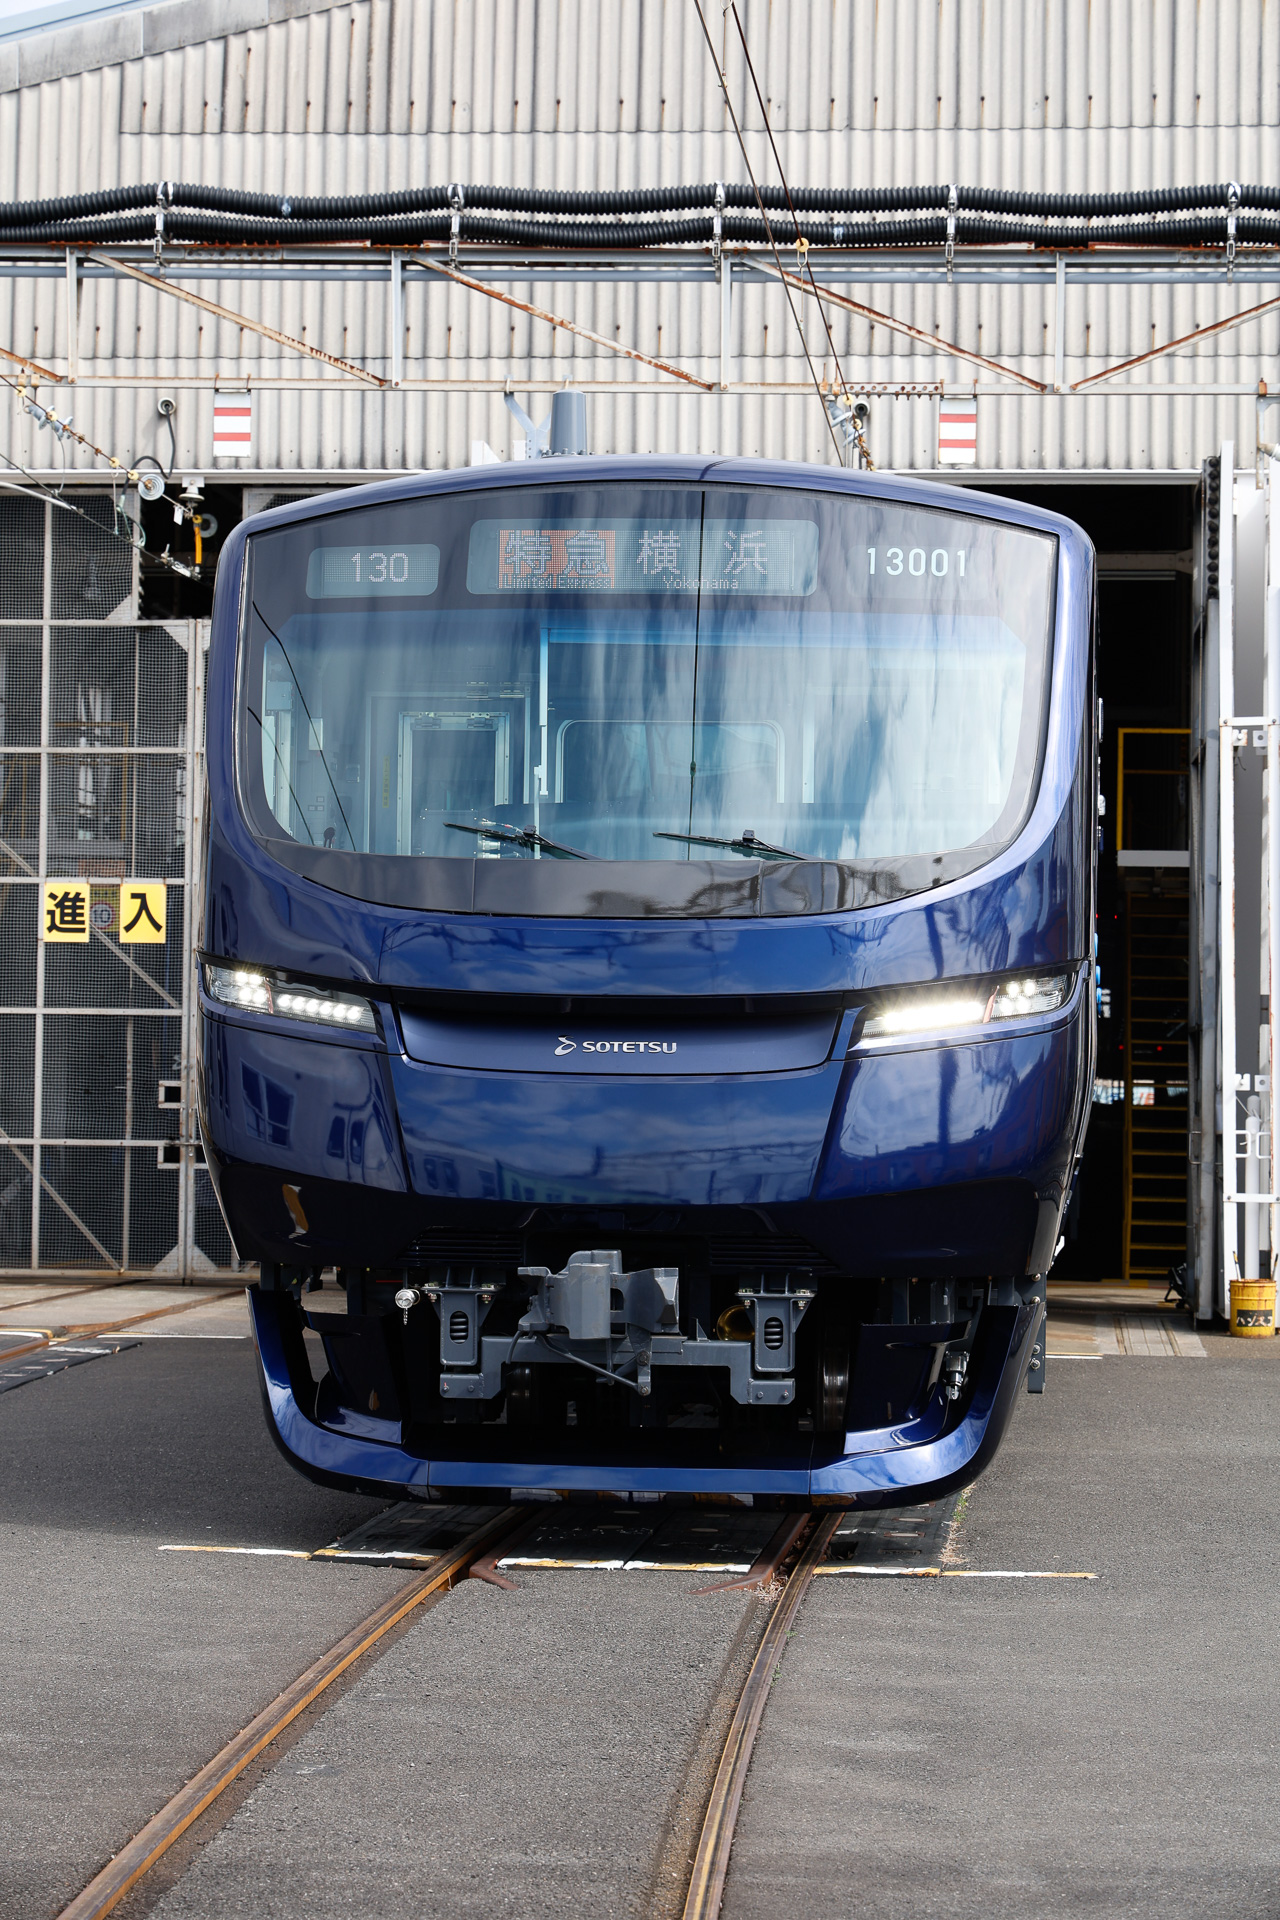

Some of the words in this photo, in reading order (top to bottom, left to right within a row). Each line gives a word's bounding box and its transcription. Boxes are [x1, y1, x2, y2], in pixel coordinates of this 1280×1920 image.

[351, 552, 409, 582] 130
[506, 530, 609, 574] 特急
[636, 530, 768, 574] 横浜
[867, 547, 966, 577] 13001
[504, 575, 552, 589] Limited
[559, 575, 609, 589] Express
[663, 575, 739, 589] Yokohama
[582, 1040, 677, 1054] SOTETSU
